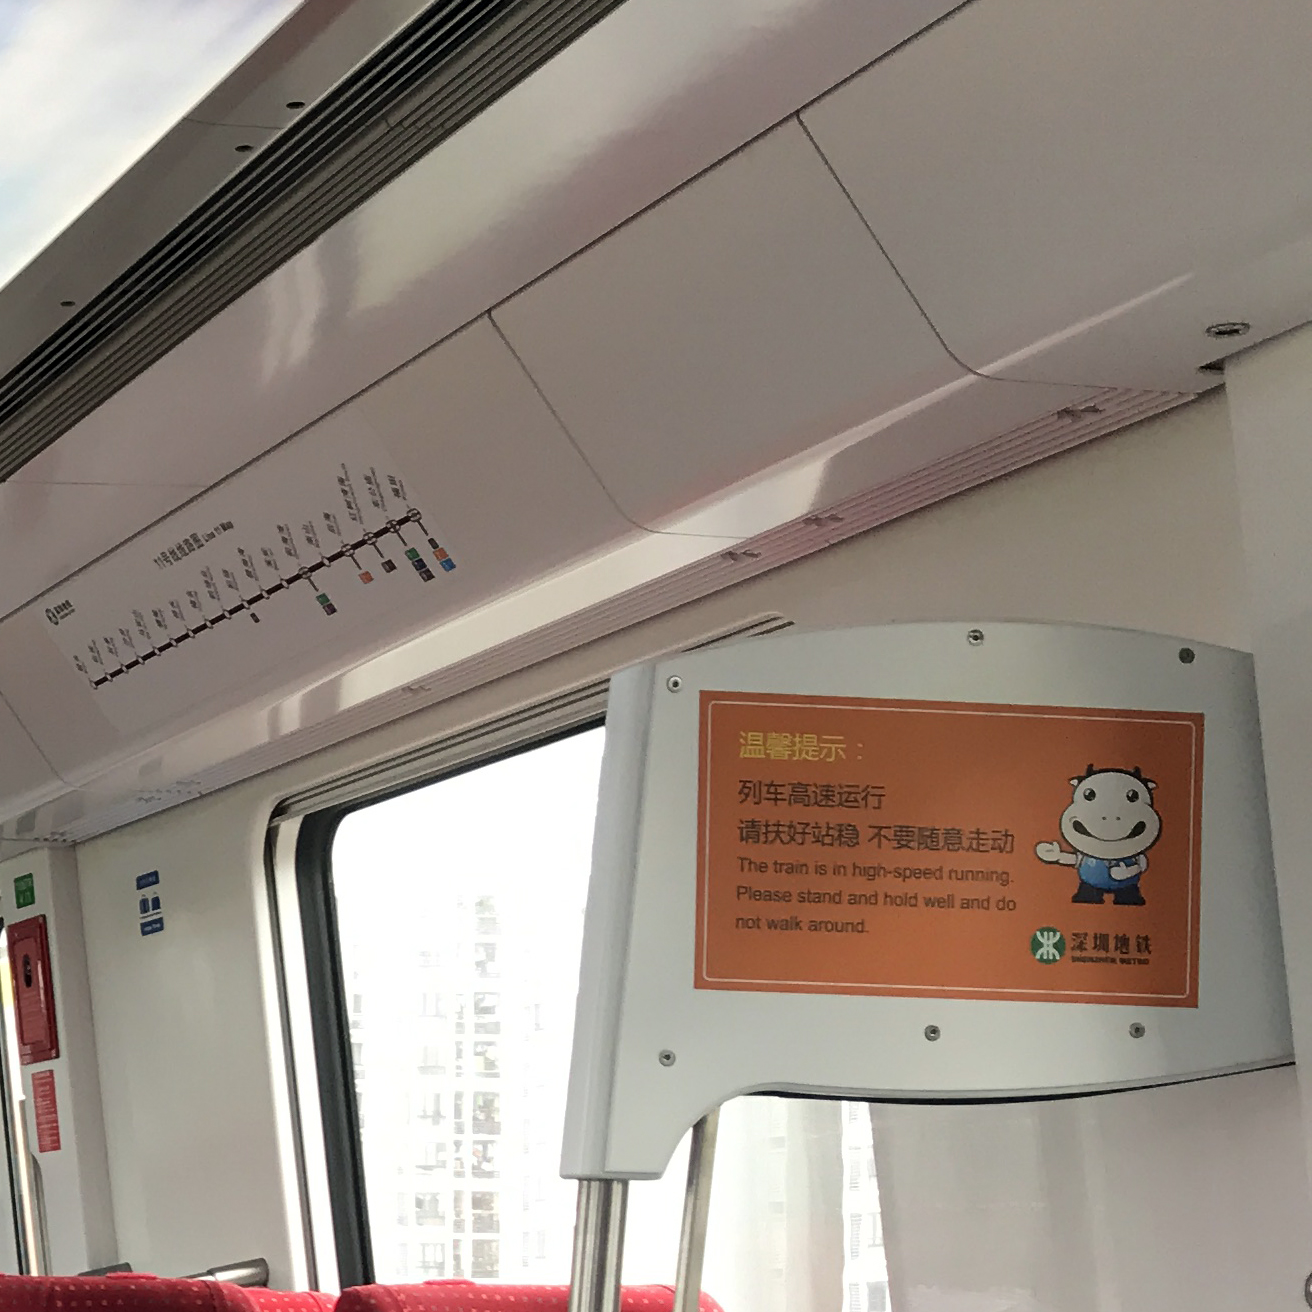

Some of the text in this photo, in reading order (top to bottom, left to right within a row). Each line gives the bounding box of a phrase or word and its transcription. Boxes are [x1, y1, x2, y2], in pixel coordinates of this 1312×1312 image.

[737, 779, 886, 810] 列车高速运行
[737, 818, 1015, 854] 请扶好站稳 不要随意走动
[737, 856, 1015, 887] The train is in high-speed running.
[736, 885, 1017, 911] Please stand and hold well and do
[735, 917, 761, 930] not
[766, 916, 803, 931] walk
[1071, 932, 1152, 955] 深圳地铁
